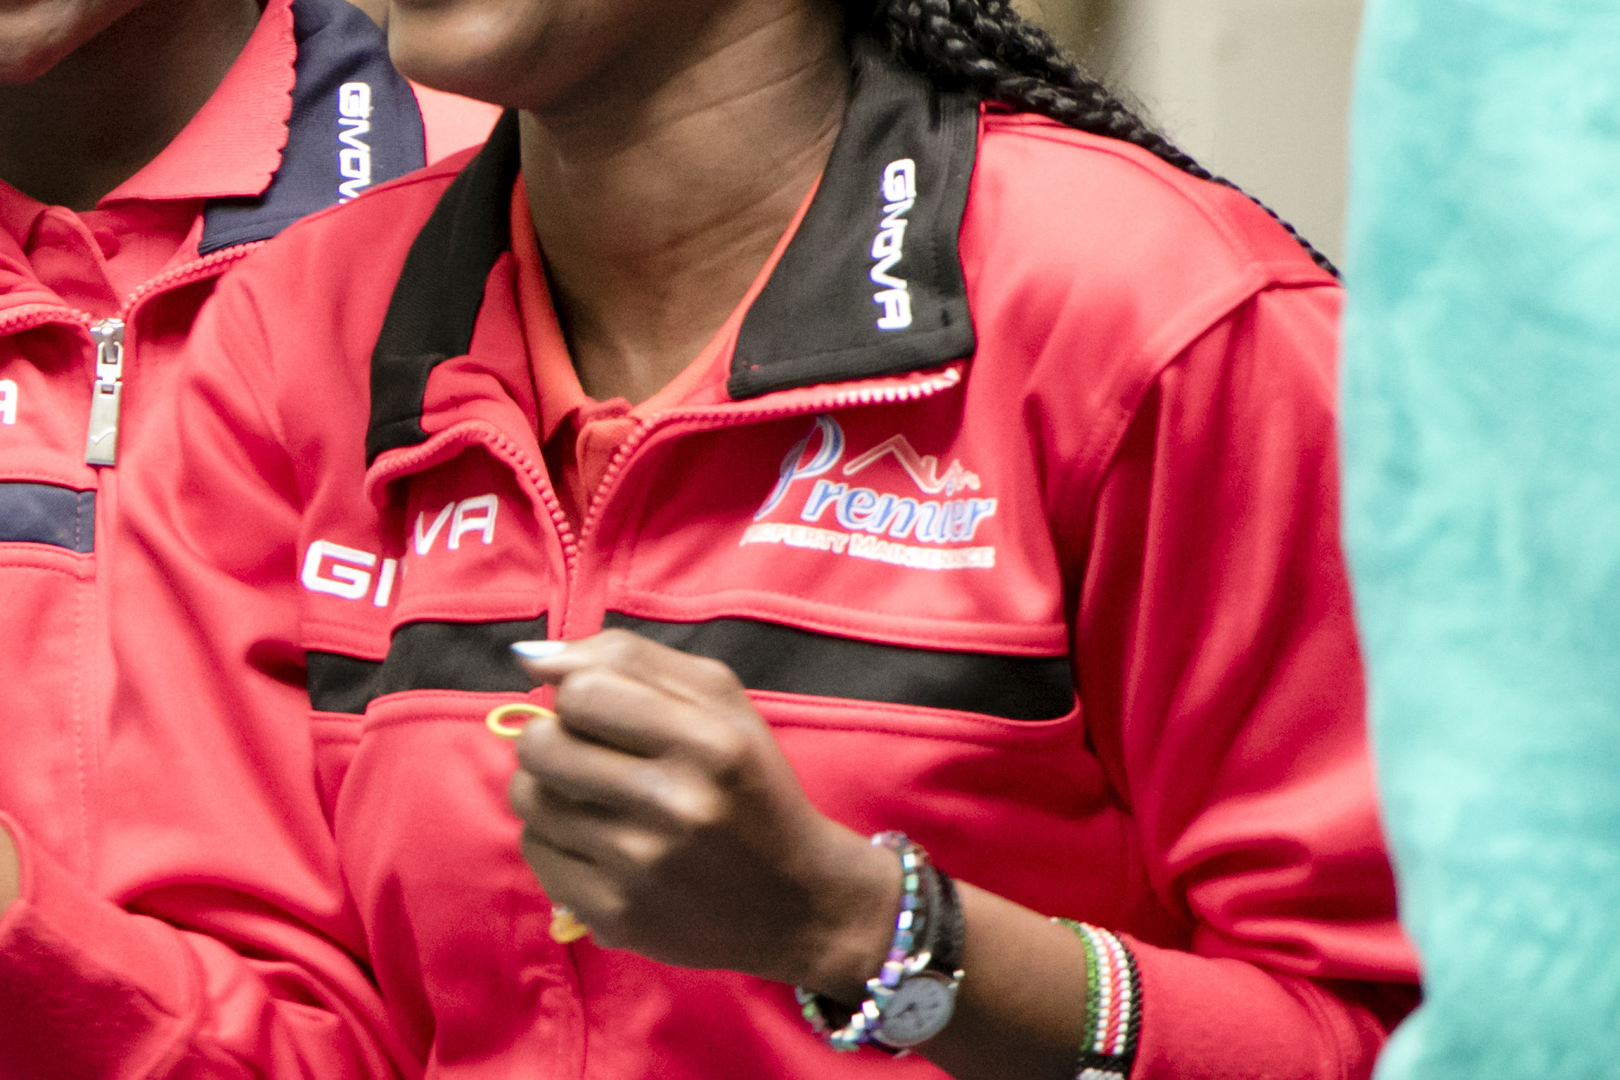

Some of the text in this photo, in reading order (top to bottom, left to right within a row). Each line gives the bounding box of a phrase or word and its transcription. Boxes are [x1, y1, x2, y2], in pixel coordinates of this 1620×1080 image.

[337, 81, 372, 205] GIVOV
[753, 413, 998, 543] Premier
[300, 493, 499, 607] GIVA
